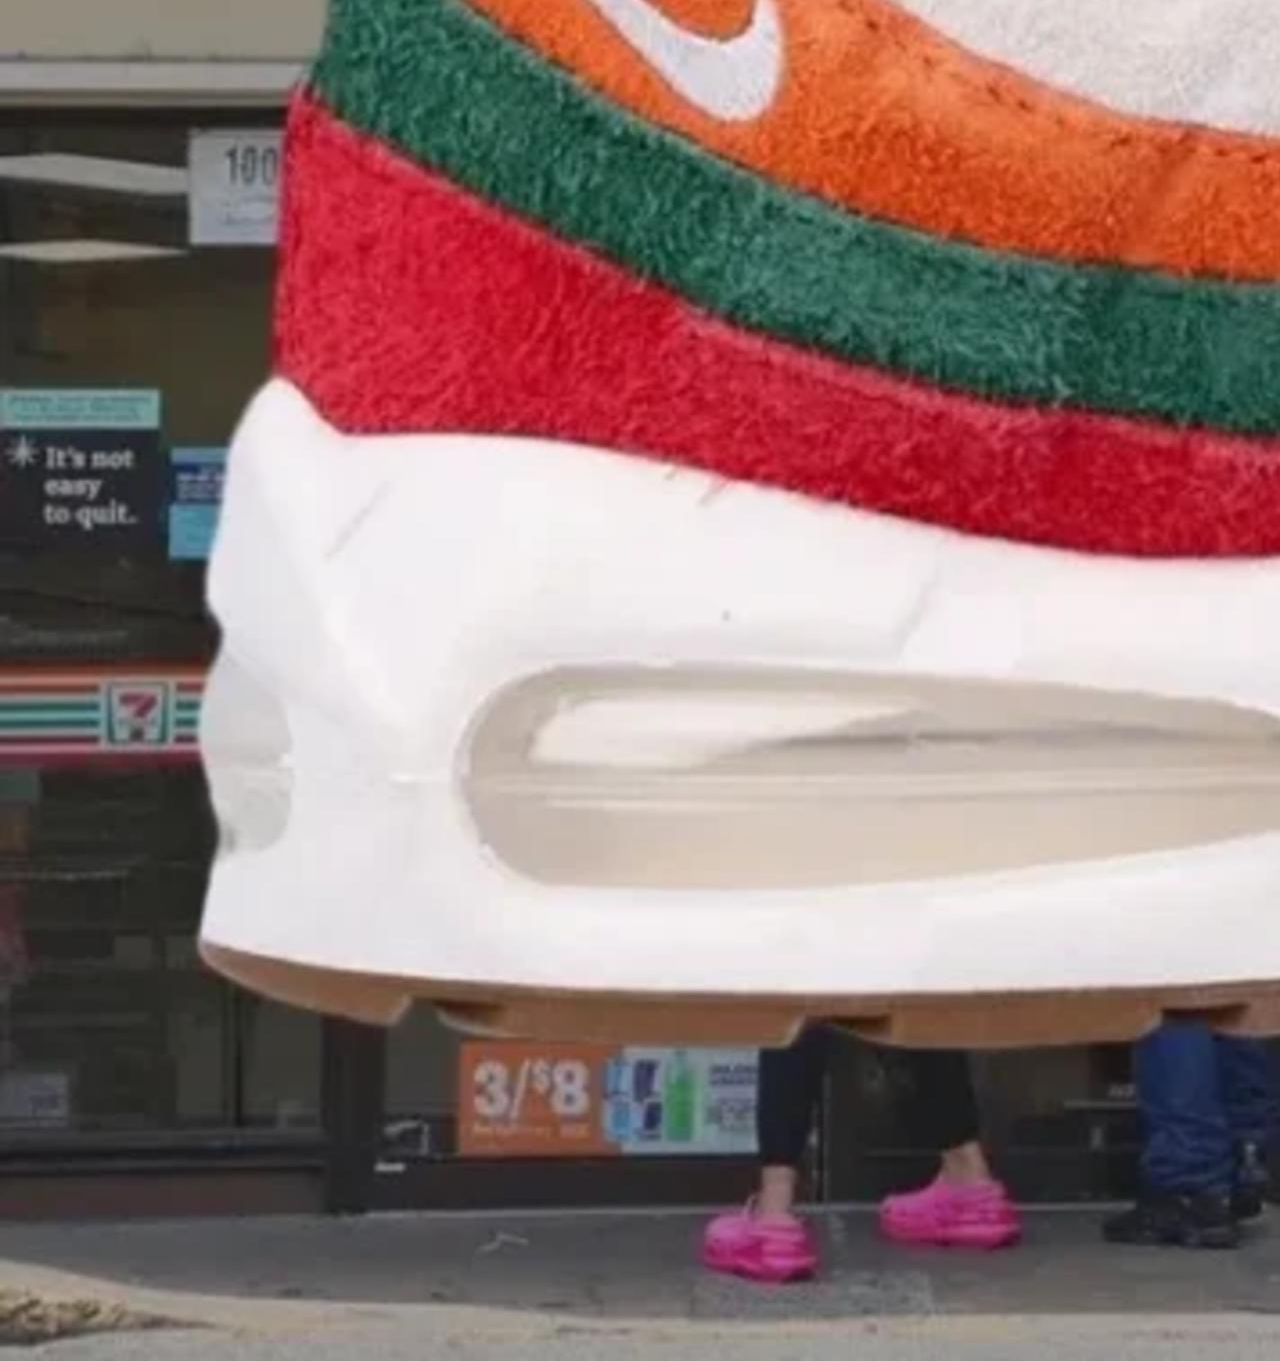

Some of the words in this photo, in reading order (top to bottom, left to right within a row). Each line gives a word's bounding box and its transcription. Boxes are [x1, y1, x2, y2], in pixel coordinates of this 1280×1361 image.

[46, 447, 86, 469] It's
[90, 450, 135, 469] not
[45, 479, 102, 500] easy
[44, 503, 70, 524] to
[75, 499, 138, 530] quit.
